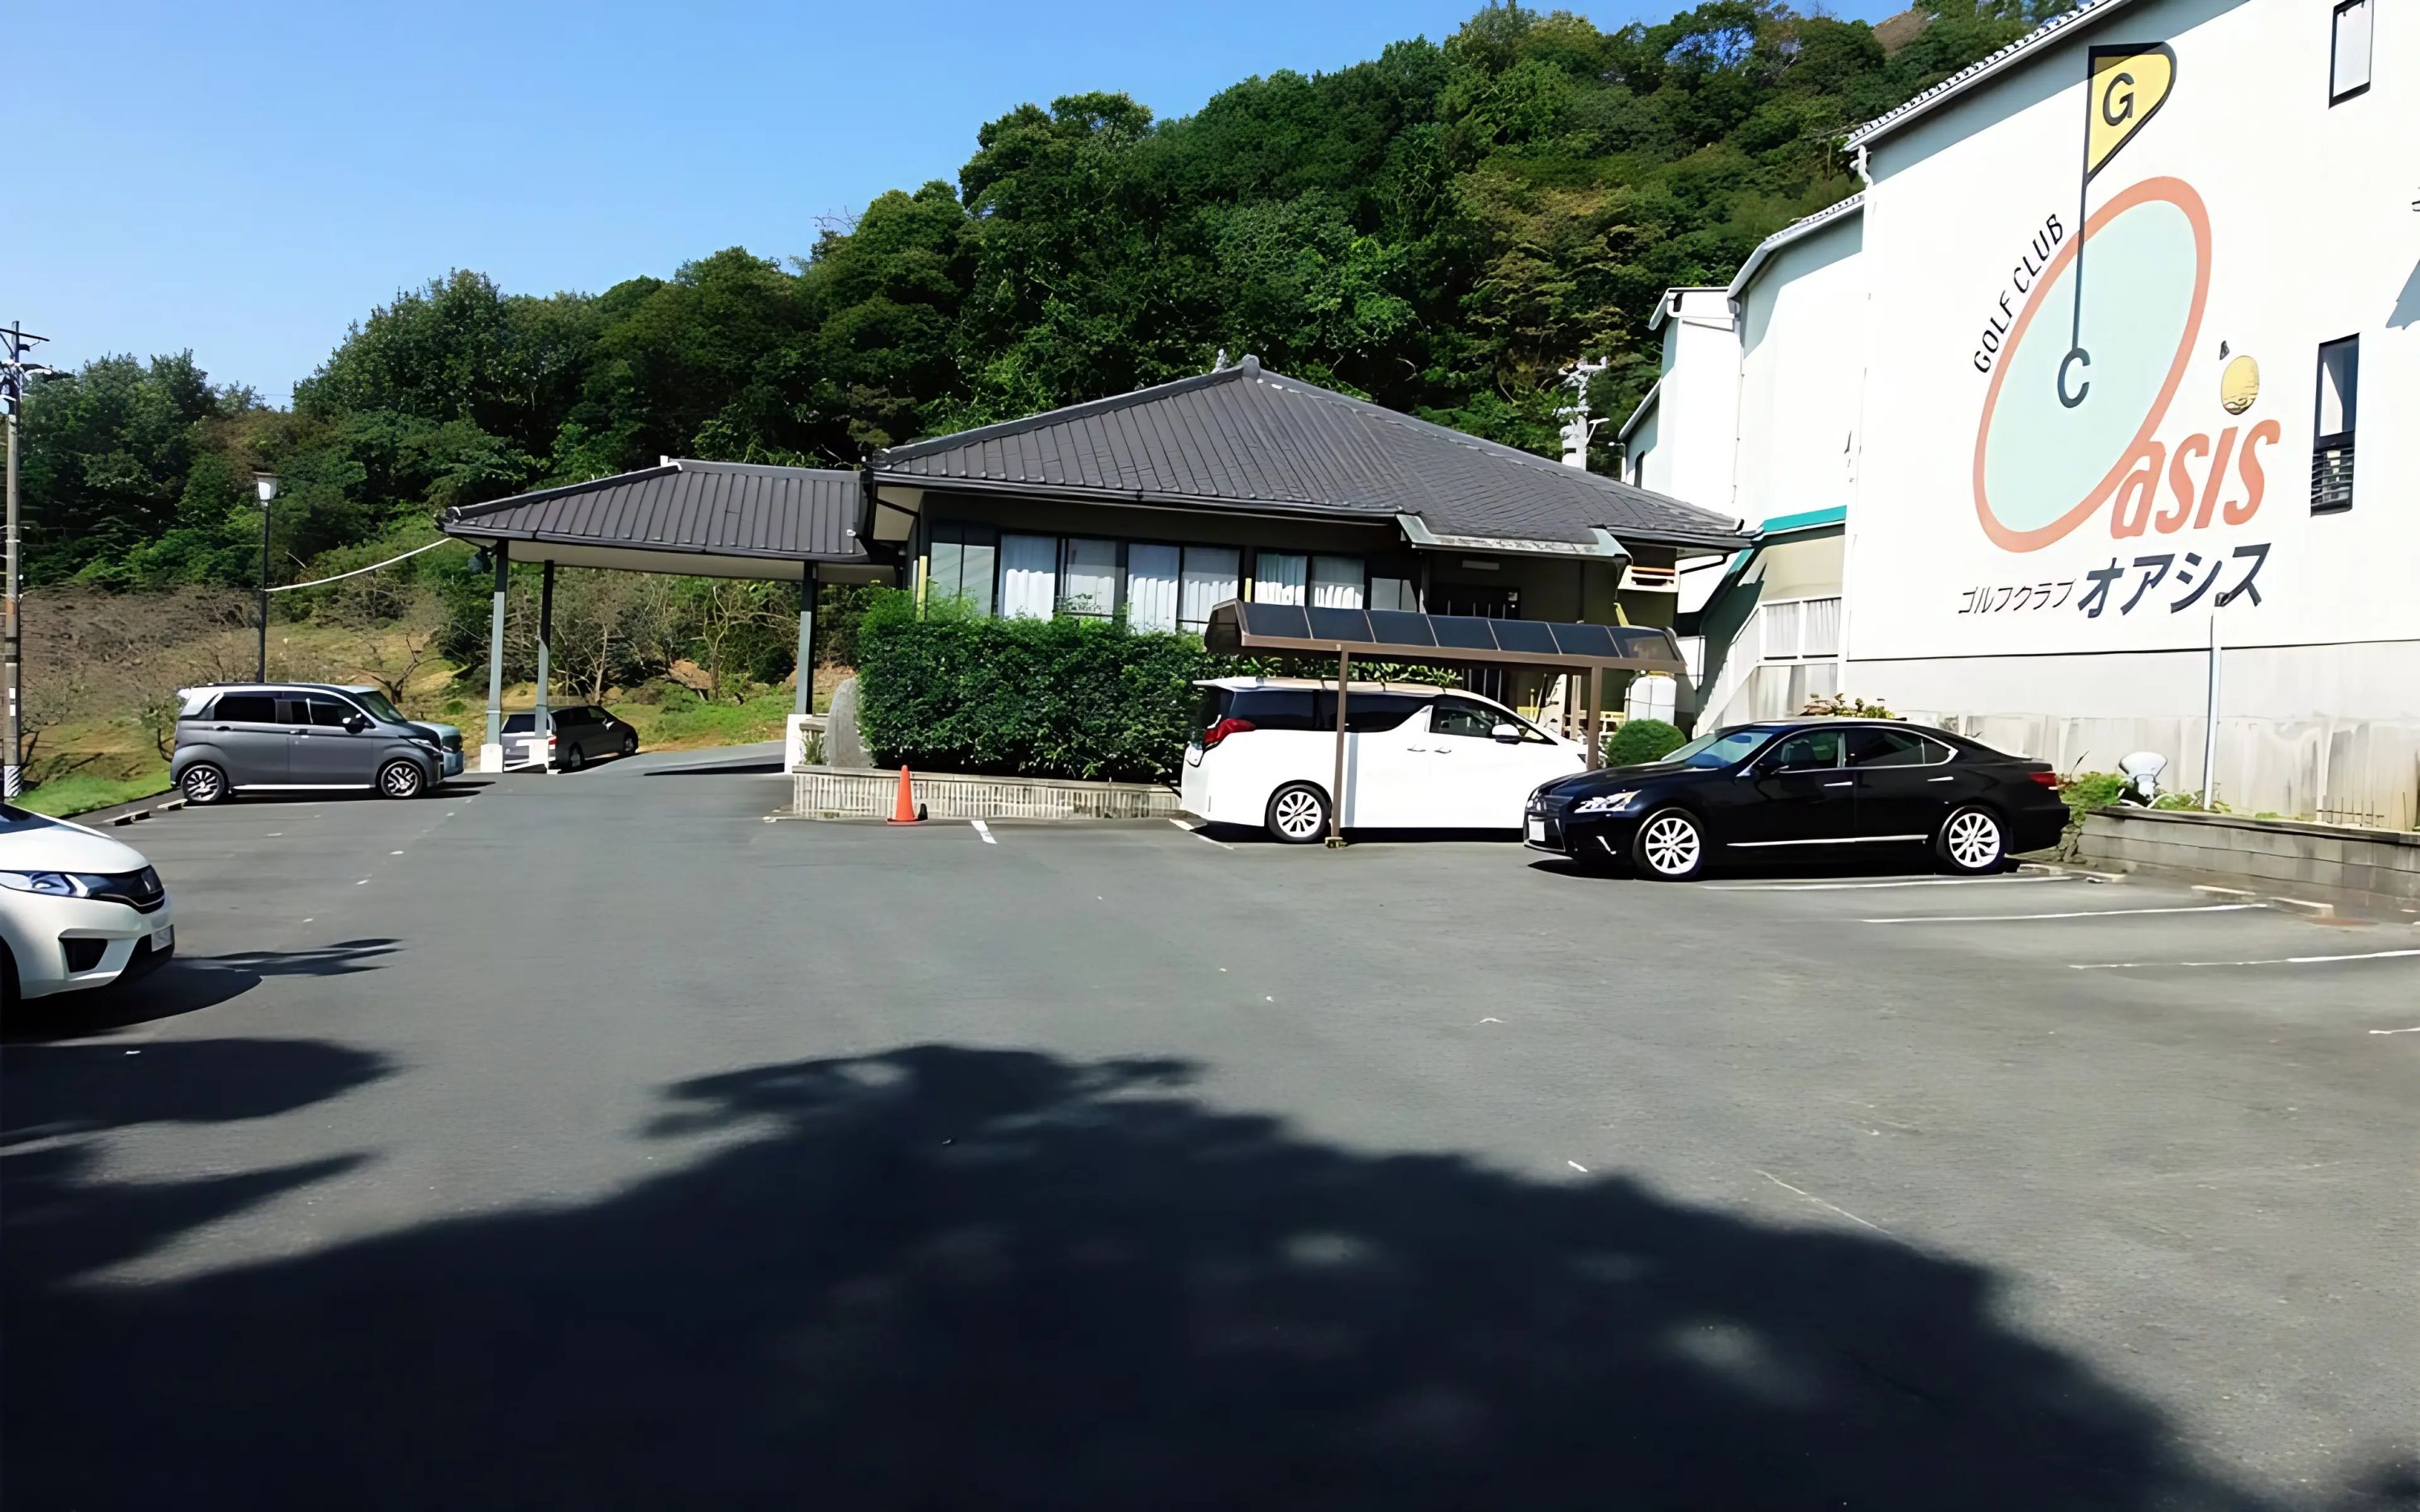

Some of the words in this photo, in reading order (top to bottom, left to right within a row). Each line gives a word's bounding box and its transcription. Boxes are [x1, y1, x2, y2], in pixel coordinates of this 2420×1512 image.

[2102, 72, 2134, 127] G
[1974, 289, 2013, 373] GOLF
[2013, 213, 2063, 294] CLUB
[2057, 347, 2091, 409] C
[2077, 542, 2272, 619] オアシス
